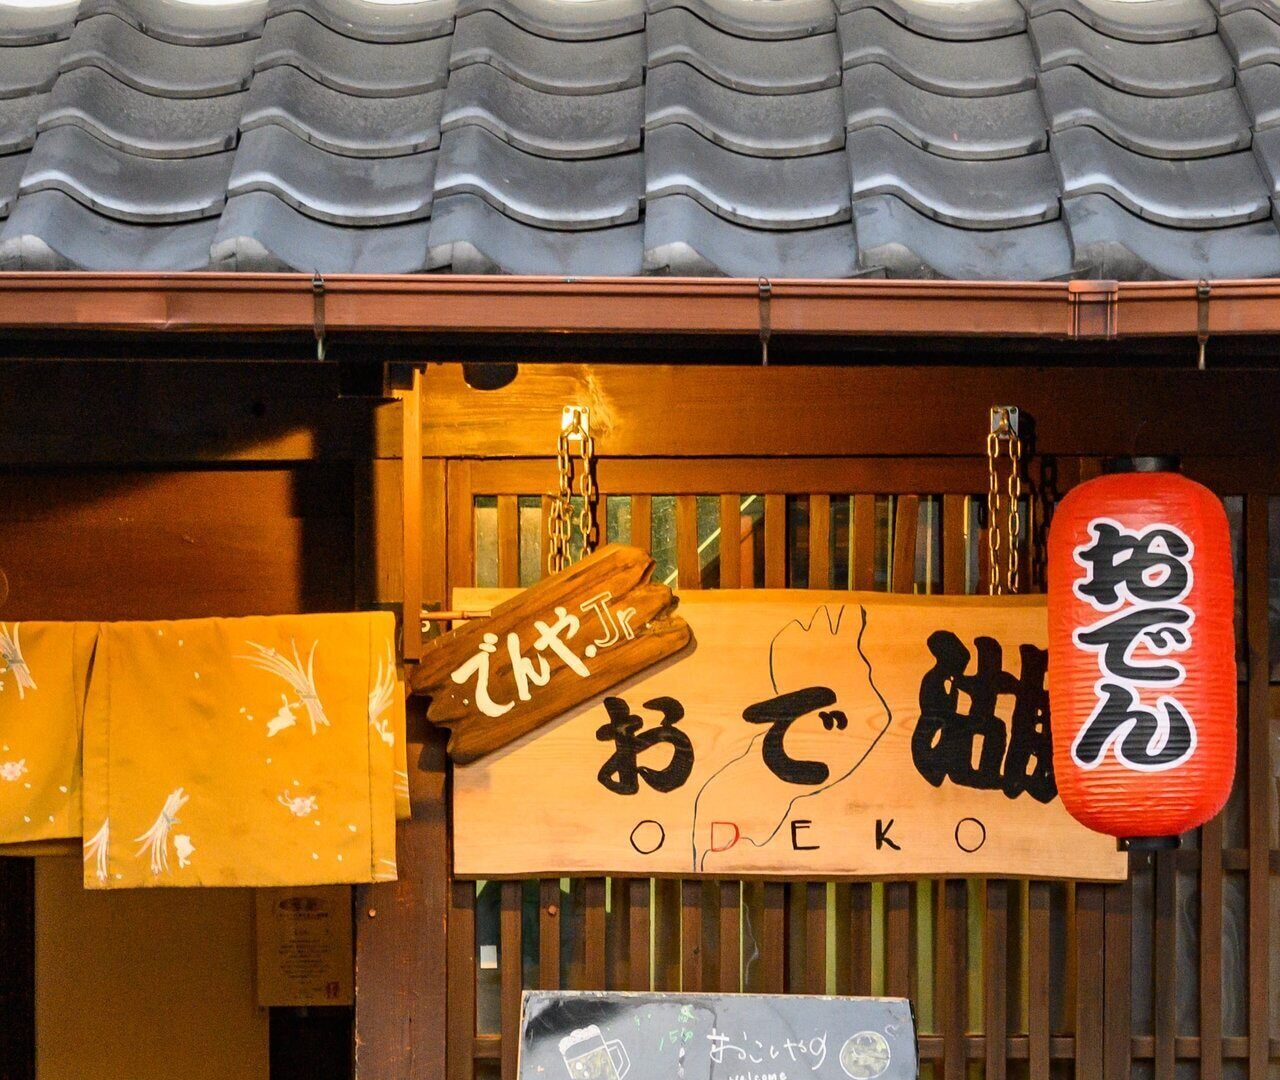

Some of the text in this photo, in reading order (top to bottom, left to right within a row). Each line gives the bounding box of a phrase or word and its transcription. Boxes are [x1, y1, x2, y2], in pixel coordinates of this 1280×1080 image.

[1072, 518, 1196, 771] おでん
[630, 818, 986, 853] ODEKO
